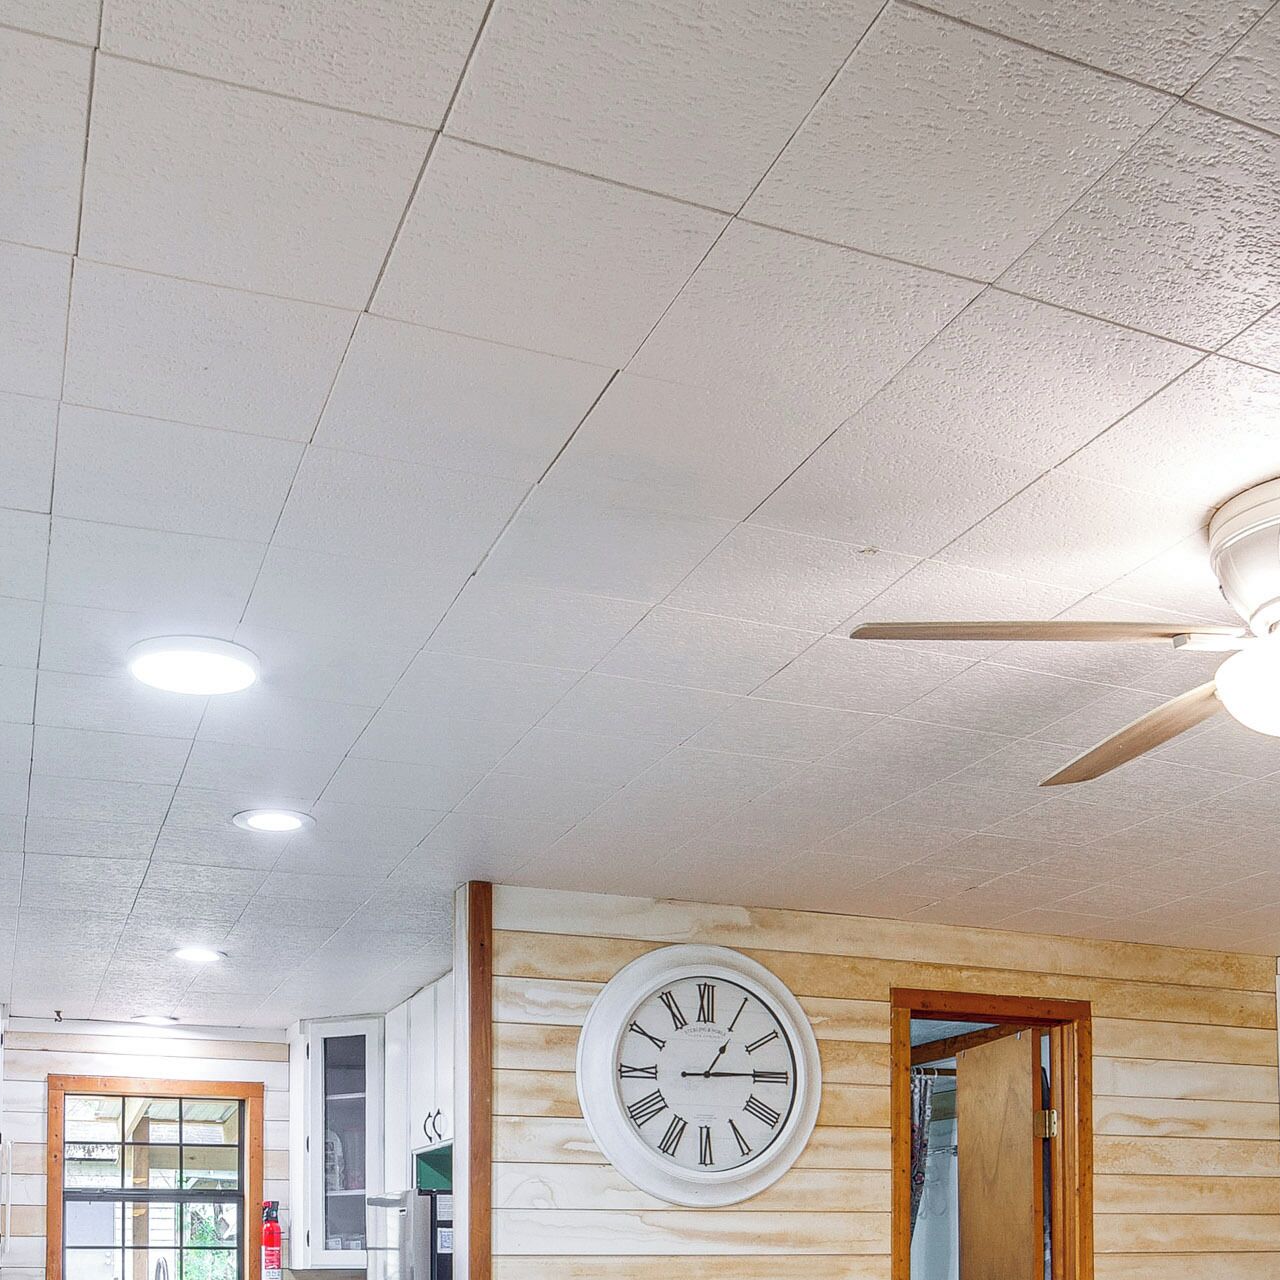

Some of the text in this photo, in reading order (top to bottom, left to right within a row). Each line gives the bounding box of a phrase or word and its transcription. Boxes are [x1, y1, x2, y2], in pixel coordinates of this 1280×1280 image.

[657, 991, 689, 1031] XI
[696, 982, 716, 1024] XII
[728, 997, 748, 1032] I
[629, 1020, 666, 1051] X
[745, 1030, 779, 1055] II
[618, 1063, 657, 1080] IX
[752, 1069, 789, 1085] III
[627, 1088, 669, 1129] VIII
[743, 1094, 781, 1129] IIII
[657, 1114, 688, 1157] VII
[698, 1125, 715, 1166] VI
[728, 1118, 752, 1157] V
